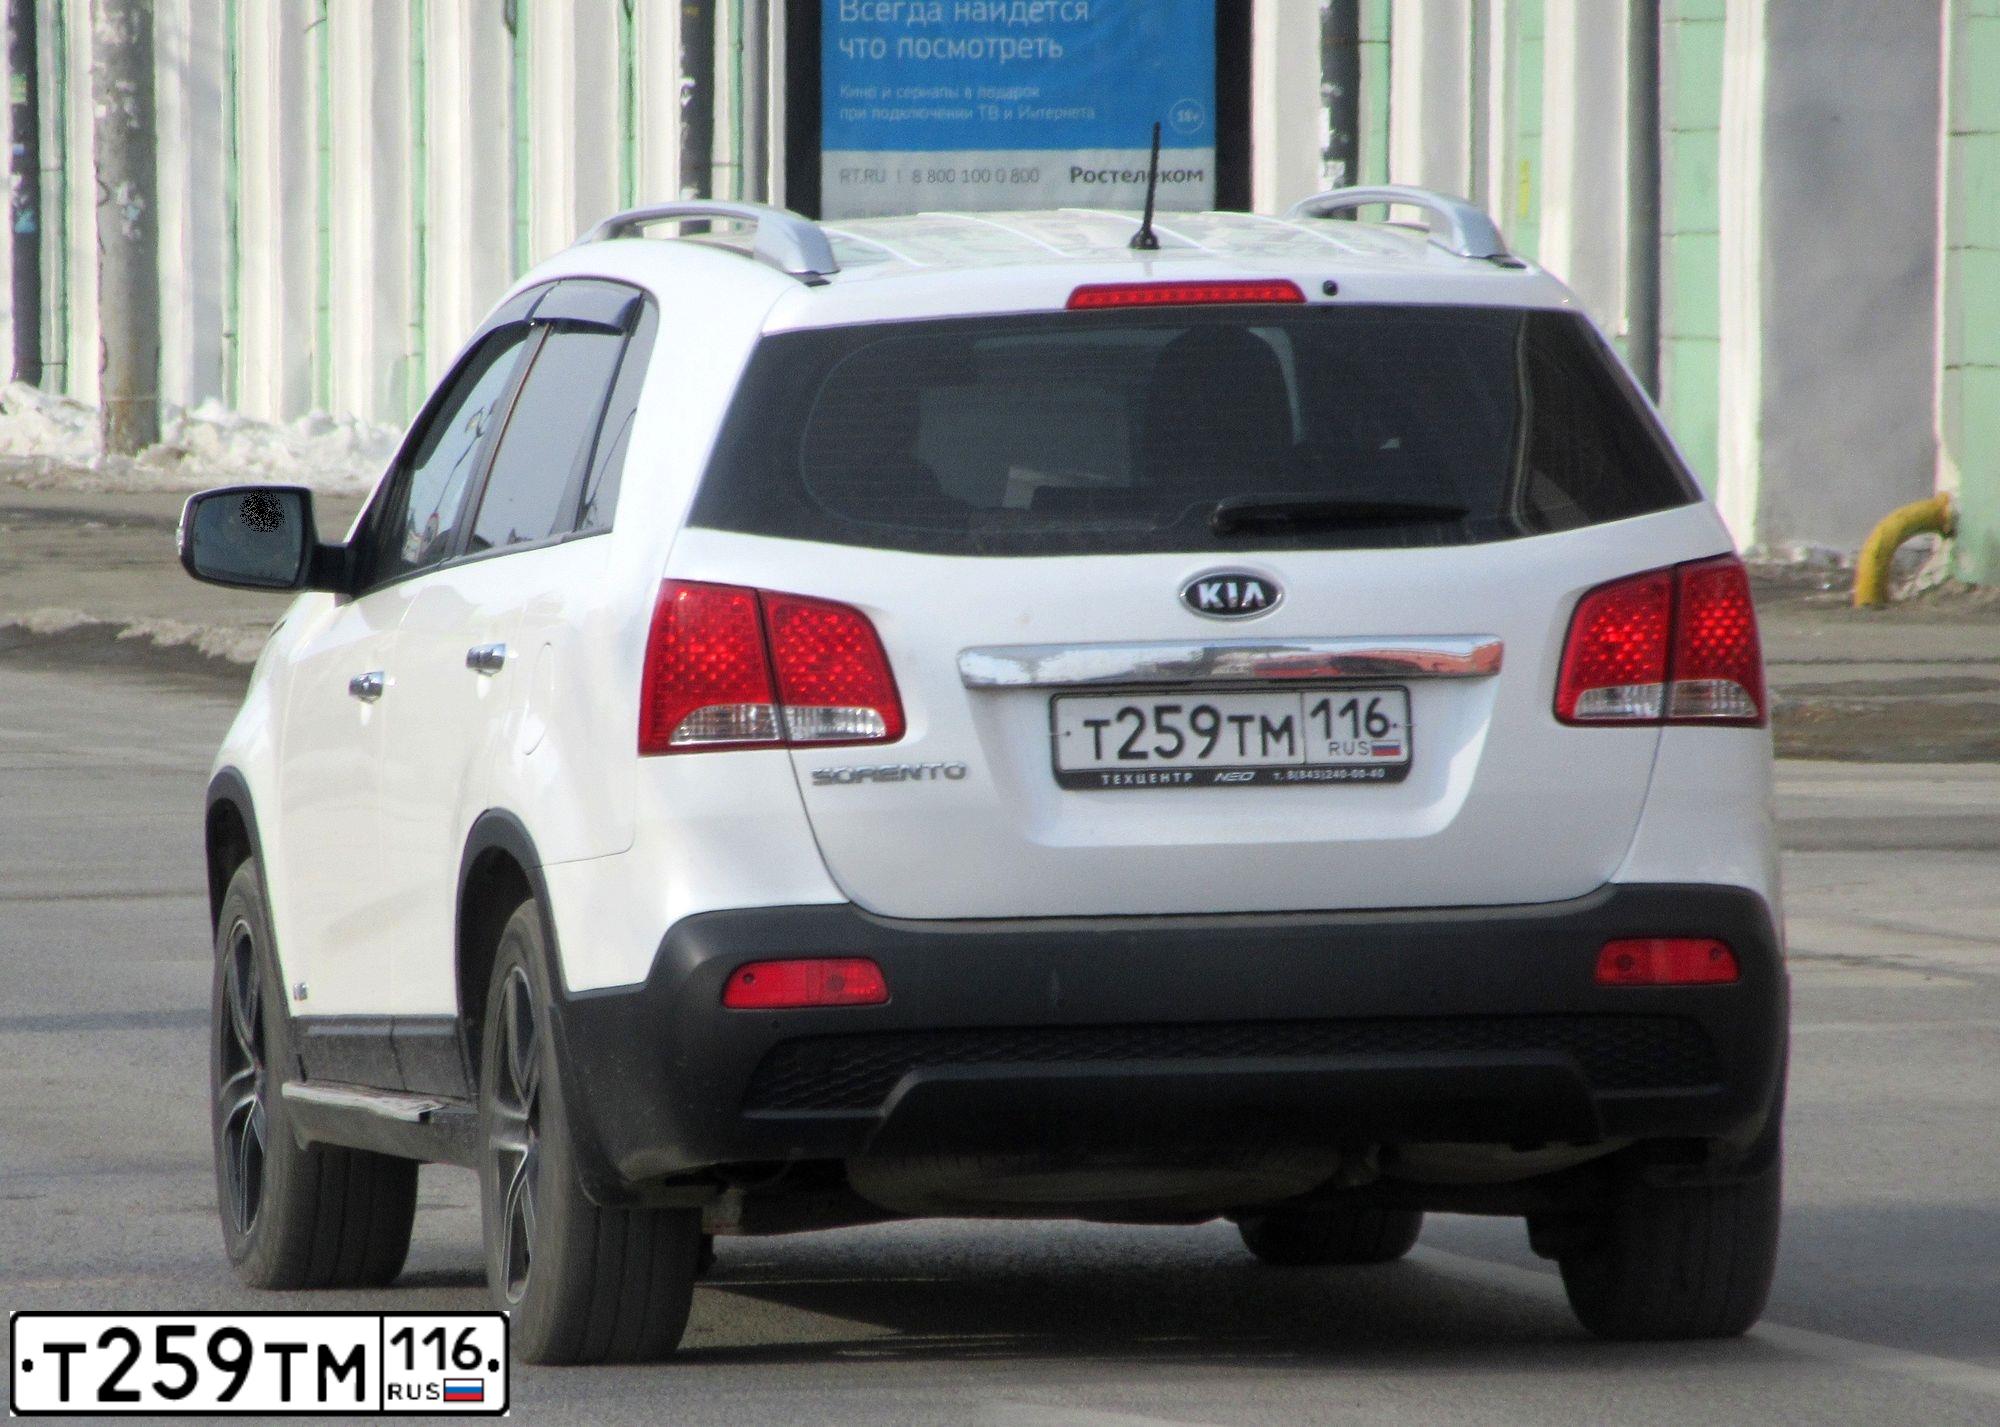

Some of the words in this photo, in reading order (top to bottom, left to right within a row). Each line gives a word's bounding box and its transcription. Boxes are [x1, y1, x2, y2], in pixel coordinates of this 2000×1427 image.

[840, 0, 943, 27] Всегда
[839, 37, 887, 60] что
[897, 37, 1064, 65] посмотреть
[882, 88, 892, 99] и
[840, 107, 867, 121] при
[871, 107, 974, 122] подключении
[977, 104, 999, 121] ТВ
[1003, 108, 1013, 120] и
[1018, 105, 1096, 120] Интернета
[839, 168, 886, 185] RT.RU
[912, 169, 922, 184] 8
[926, 168, 956, 184] 800
[962, 168, 991, 184] 100
[1009, 168, 1040, 184] 800
[1069, 165, 1204, 184] Ростелком
[1197, 581, 1267, 609] KIA
[1083, 704, 1296, 761] Т259ТМ
[1309, 697, 1391, 740] 116
[1328, 740, 1371, 757] RUS
[811, 762, 968, 786] SORENTO
[1101, 771, 1194, 786] ТЕХЦЕНТР
[1214, 771, 1256, 783] NEO
